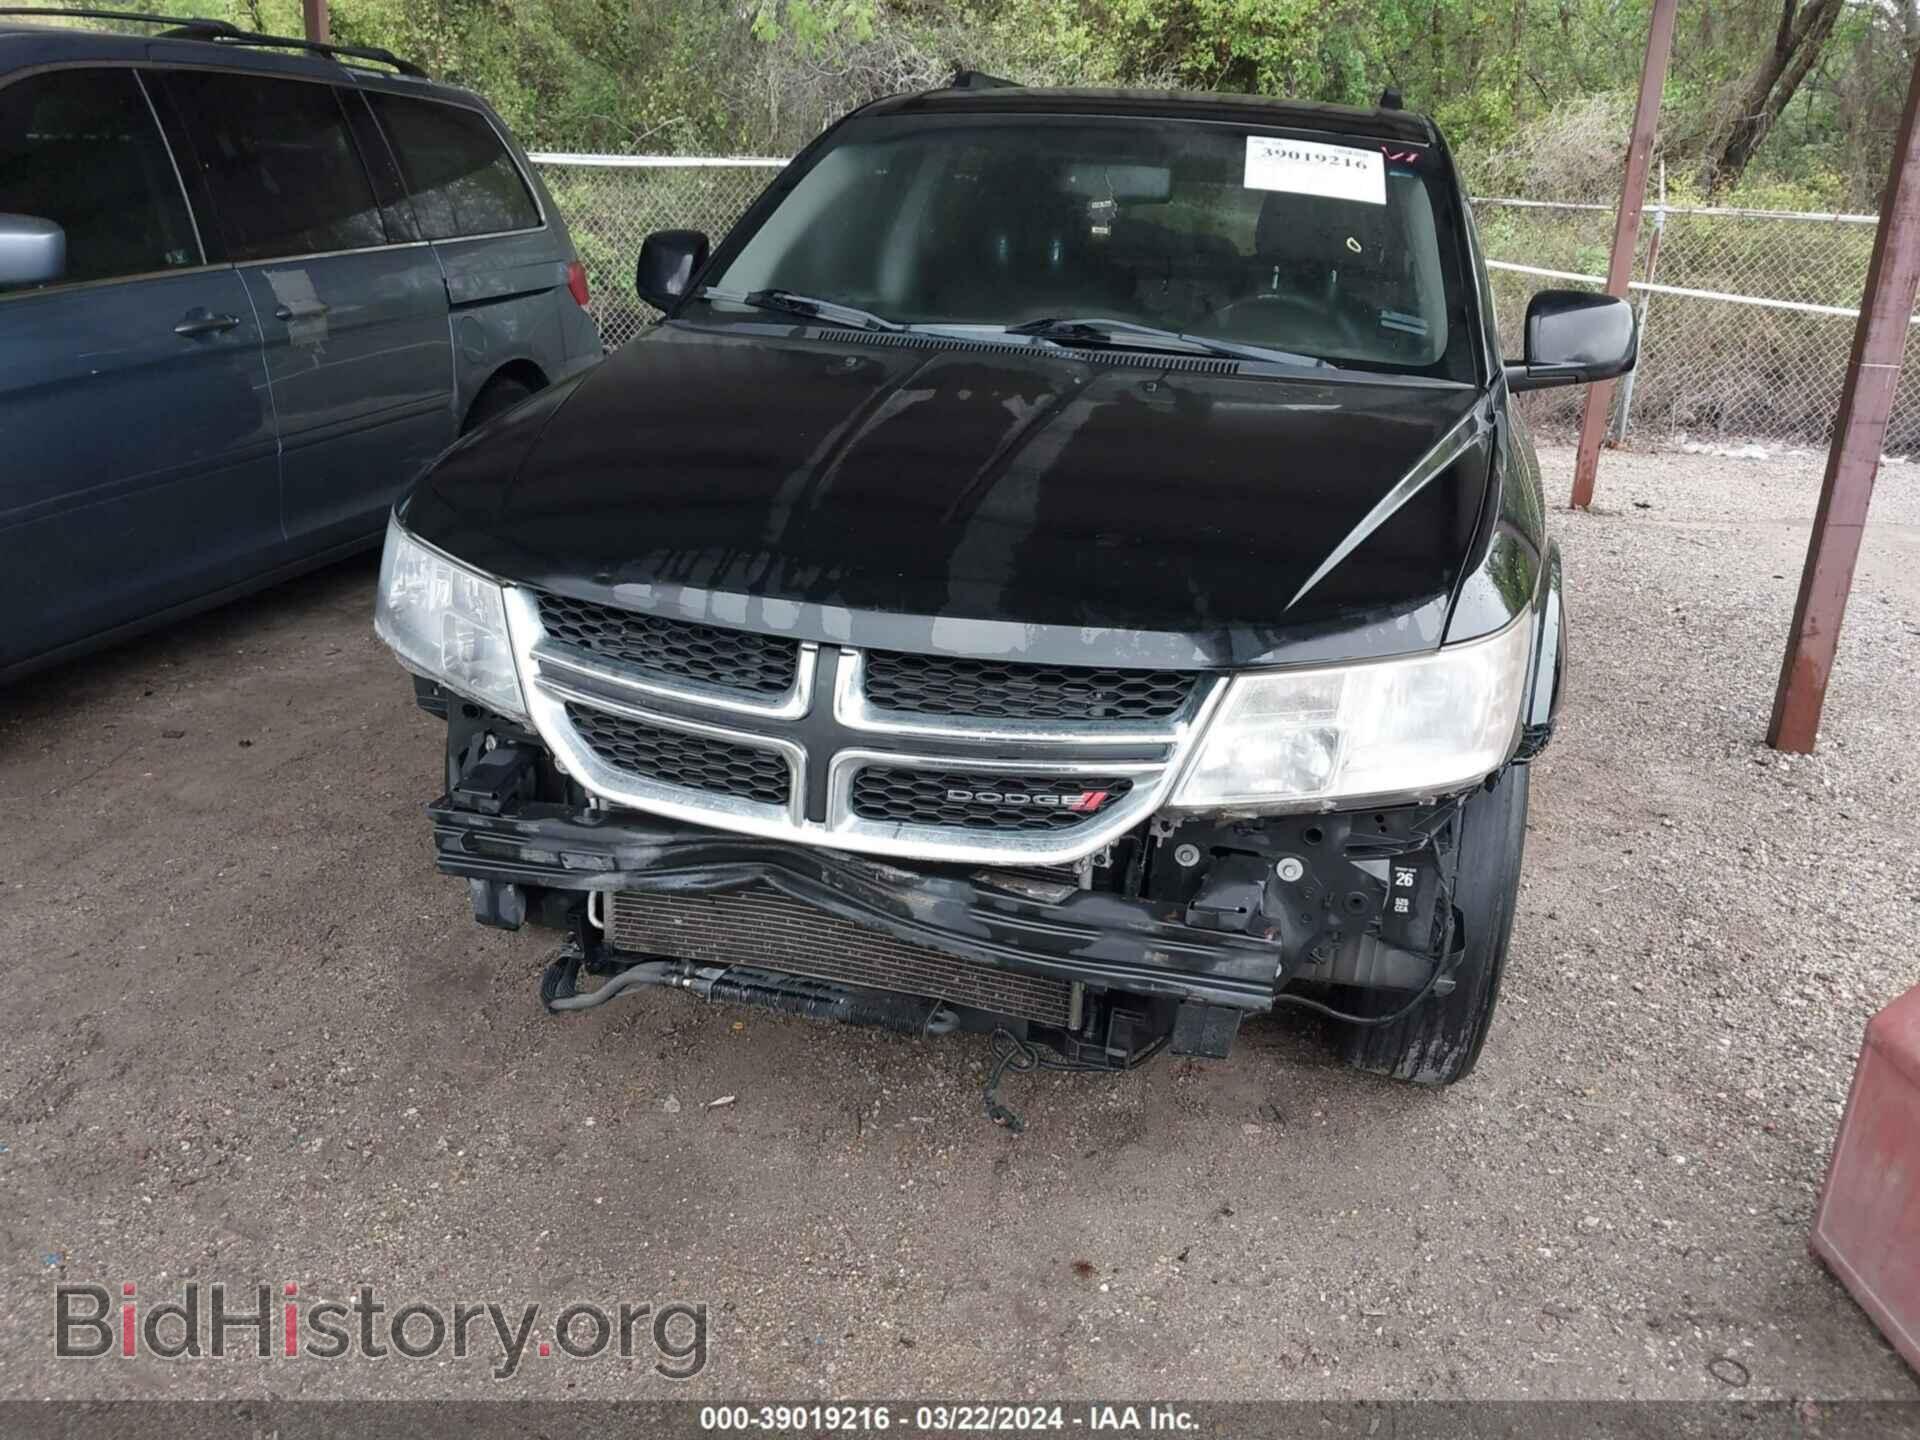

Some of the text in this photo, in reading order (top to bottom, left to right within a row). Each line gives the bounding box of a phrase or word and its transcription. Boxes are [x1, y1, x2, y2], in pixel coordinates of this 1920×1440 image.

[1262, 147, 1368, 170] 39019216
[947, 789, 1087, 806] DODGE
[1395, 872, 1414, 887] 26
